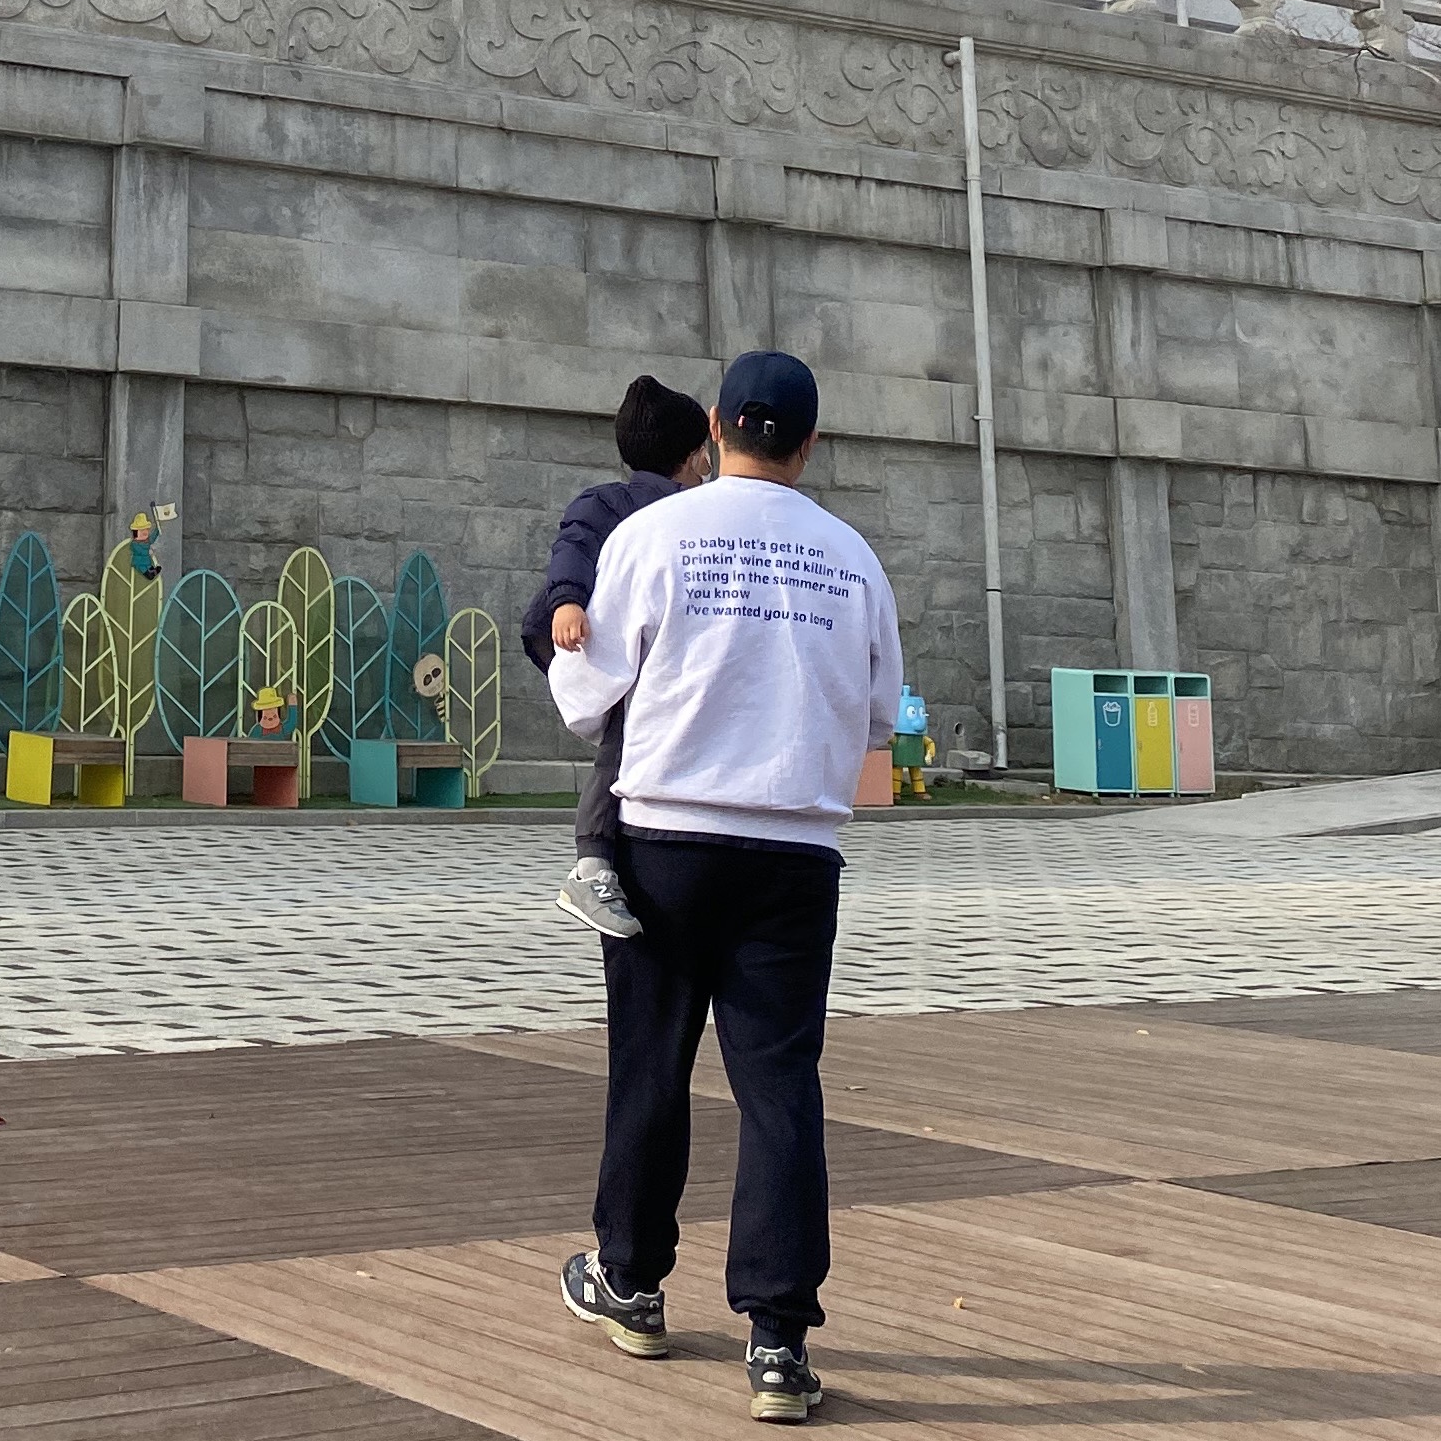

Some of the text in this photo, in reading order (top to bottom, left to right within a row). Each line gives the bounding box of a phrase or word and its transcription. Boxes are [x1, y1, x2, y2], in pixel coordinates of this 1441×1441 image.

[679, 537, 824, 559] So baby let's get it on
[682, 553, 867, 586] Drinkin' wine and killin' time
[683, 570, 849, 598] Sitting in the summer sun
[685, 587, 750, 599] You know
[685, 604, 833, 630] I've wanted you so long
